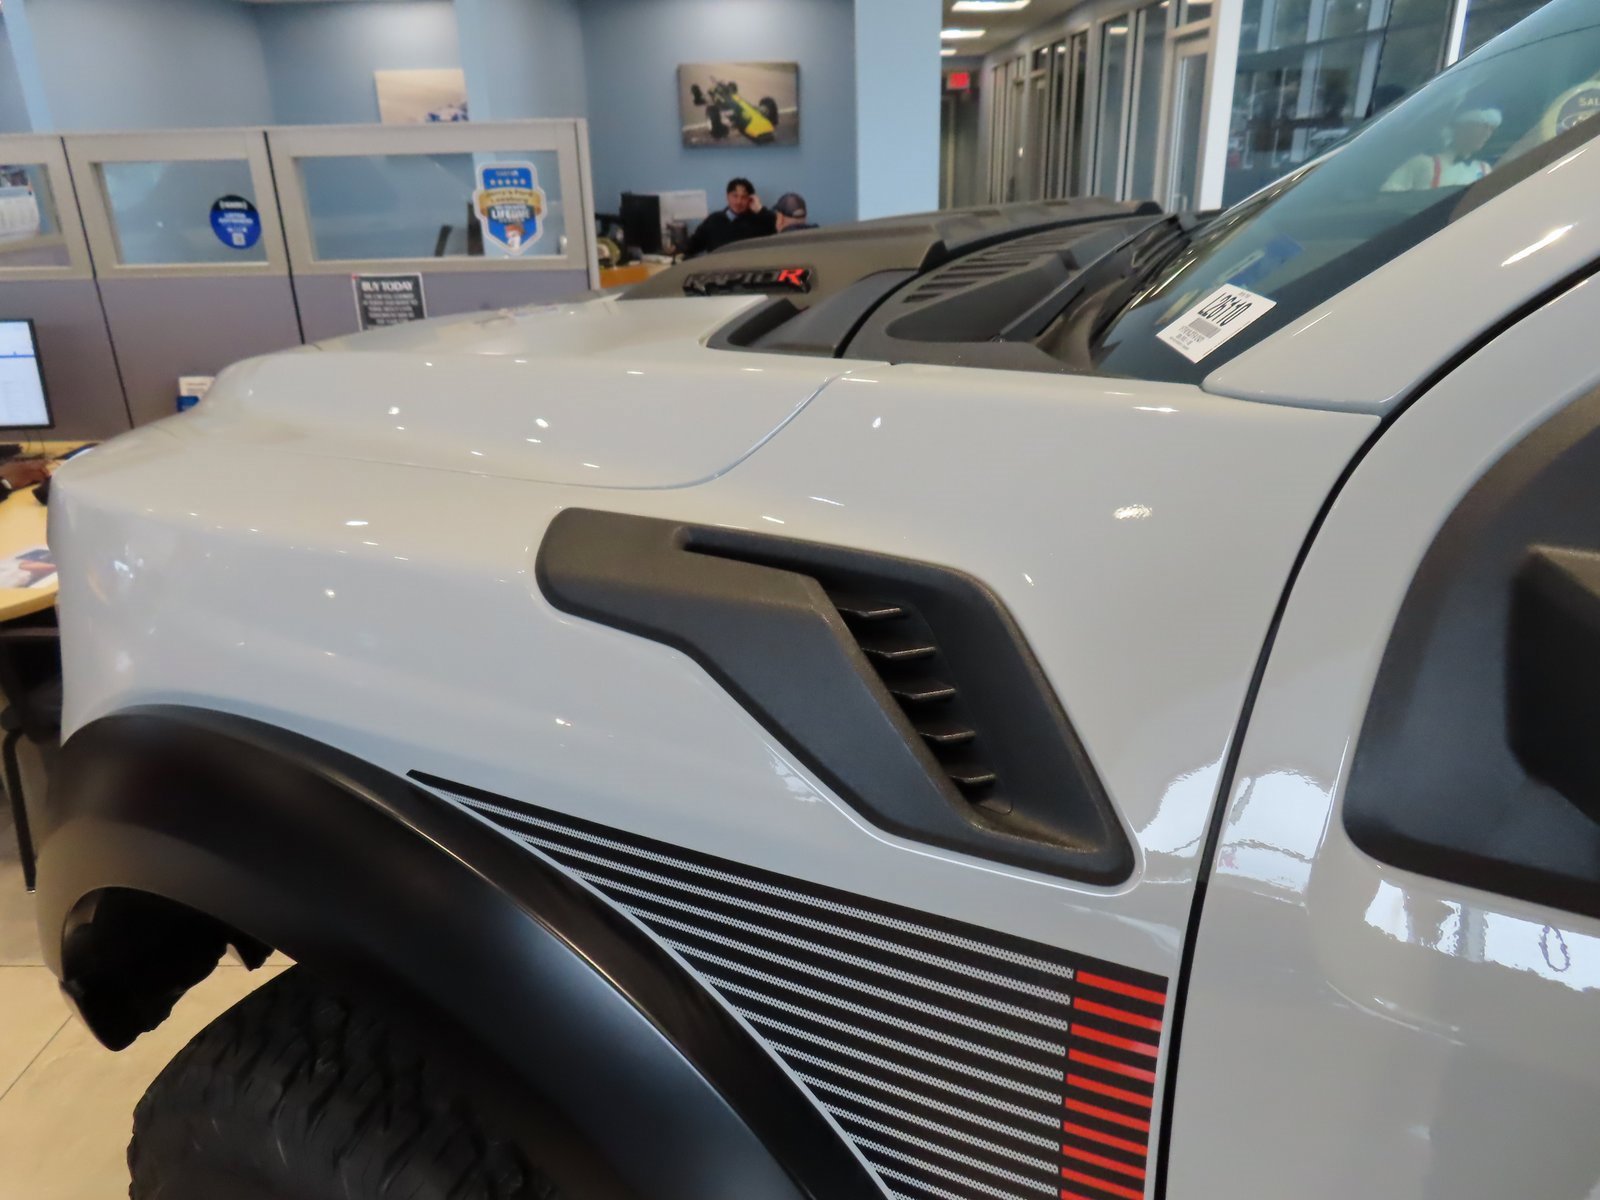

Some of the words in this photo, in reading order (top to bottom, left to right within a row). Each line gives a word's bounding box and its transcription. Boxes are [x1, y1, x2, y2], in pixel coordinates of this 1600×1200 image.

[361, 281, 379, 292] BUY
[381, 280, 413, 292] TODAY
[683, 268, 804, 291] RAPTOR
[1198, 292, 1252, 327] L26110
